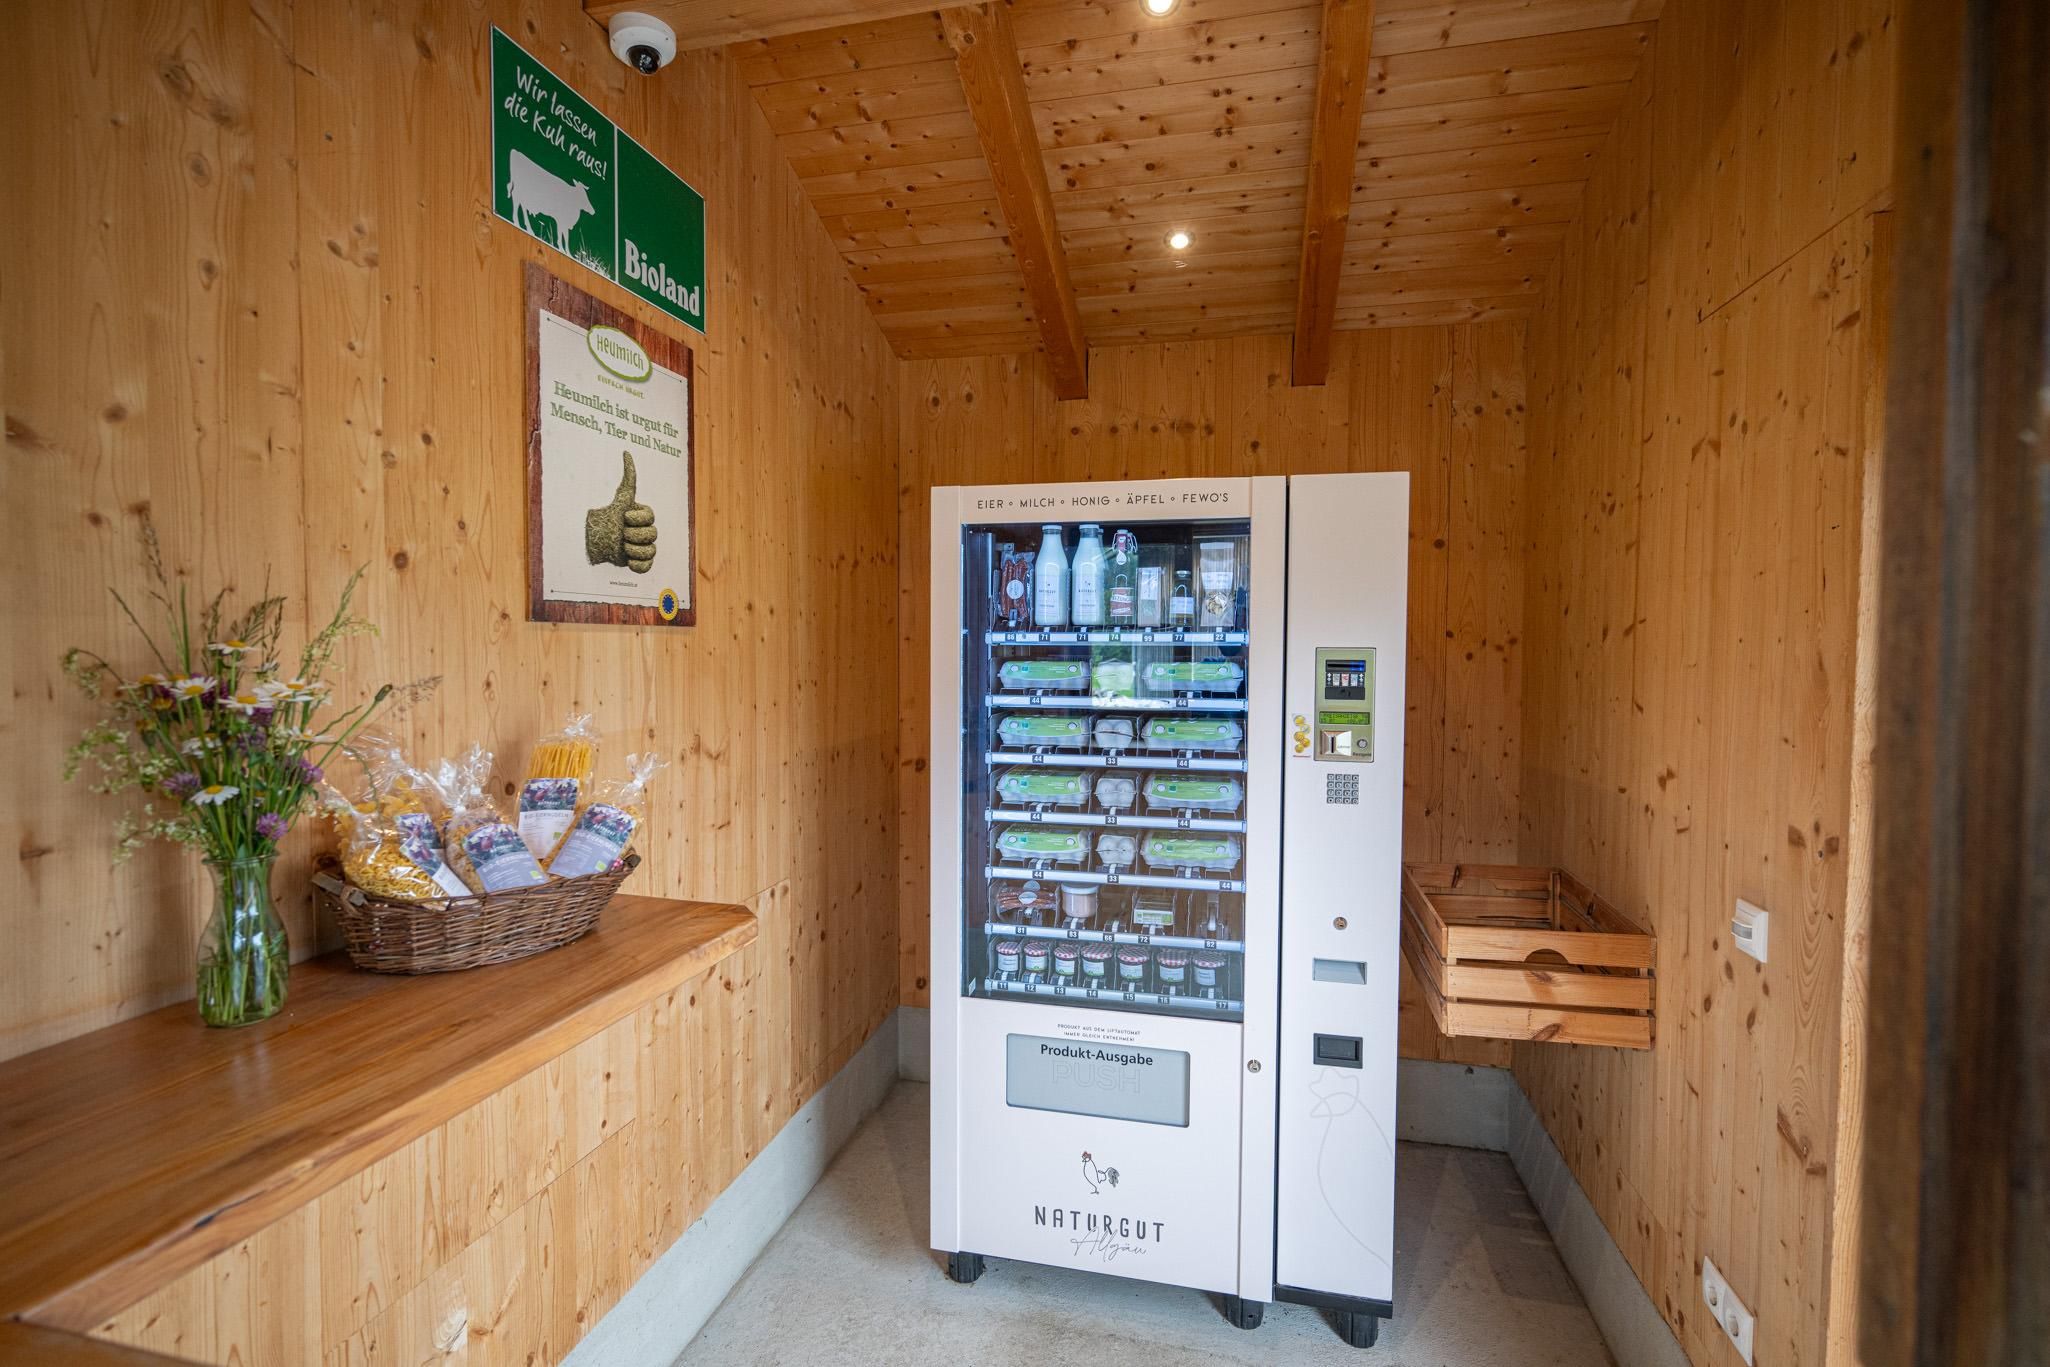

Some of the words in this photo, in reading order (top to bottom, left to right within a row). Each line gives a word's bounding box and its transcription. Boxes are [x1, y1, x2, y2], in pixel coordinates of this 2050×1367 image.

[516, 65, 548, 102] Wir
[550, 91, 597, 147] lassen
[504, 92, 528, 123] die
[533, 110, 565, 152] Kuh
[568, 143, 607, 181] raus!
[624, 238, 700, 317] Bioland
[596, 334, 644, 371] Heumilch
[553, 380, 614, 415] Heumilch
[615, 403, 630, 421] ist
[631, 413, 662, 432] urgut
[663, 422, 679, 439] für
[550, 402, 603, 434] Mensch,
[604, 421, 628, 440] Tier
[630, 432, 651, 448] und
[653, 437, 682, 458] Natur
[977, 499, 1004, 509] EIER
[1019, 497, 1055, 507] MILCH
[1072, 496, 1110, 506] HONIG
[1126, 493, 1165, 505] ÄPFEL
[1182, 493, 1229, 503] FEWO'S
[1040, 1044, 1153, 1066] Produkt-Ausgabe
[1052, 1060, 1141, 1094] PUSH
[1034, 1205, 1165, 1242] NATURGUT
[1070, 1226, 1147, 1262] Allgäu
